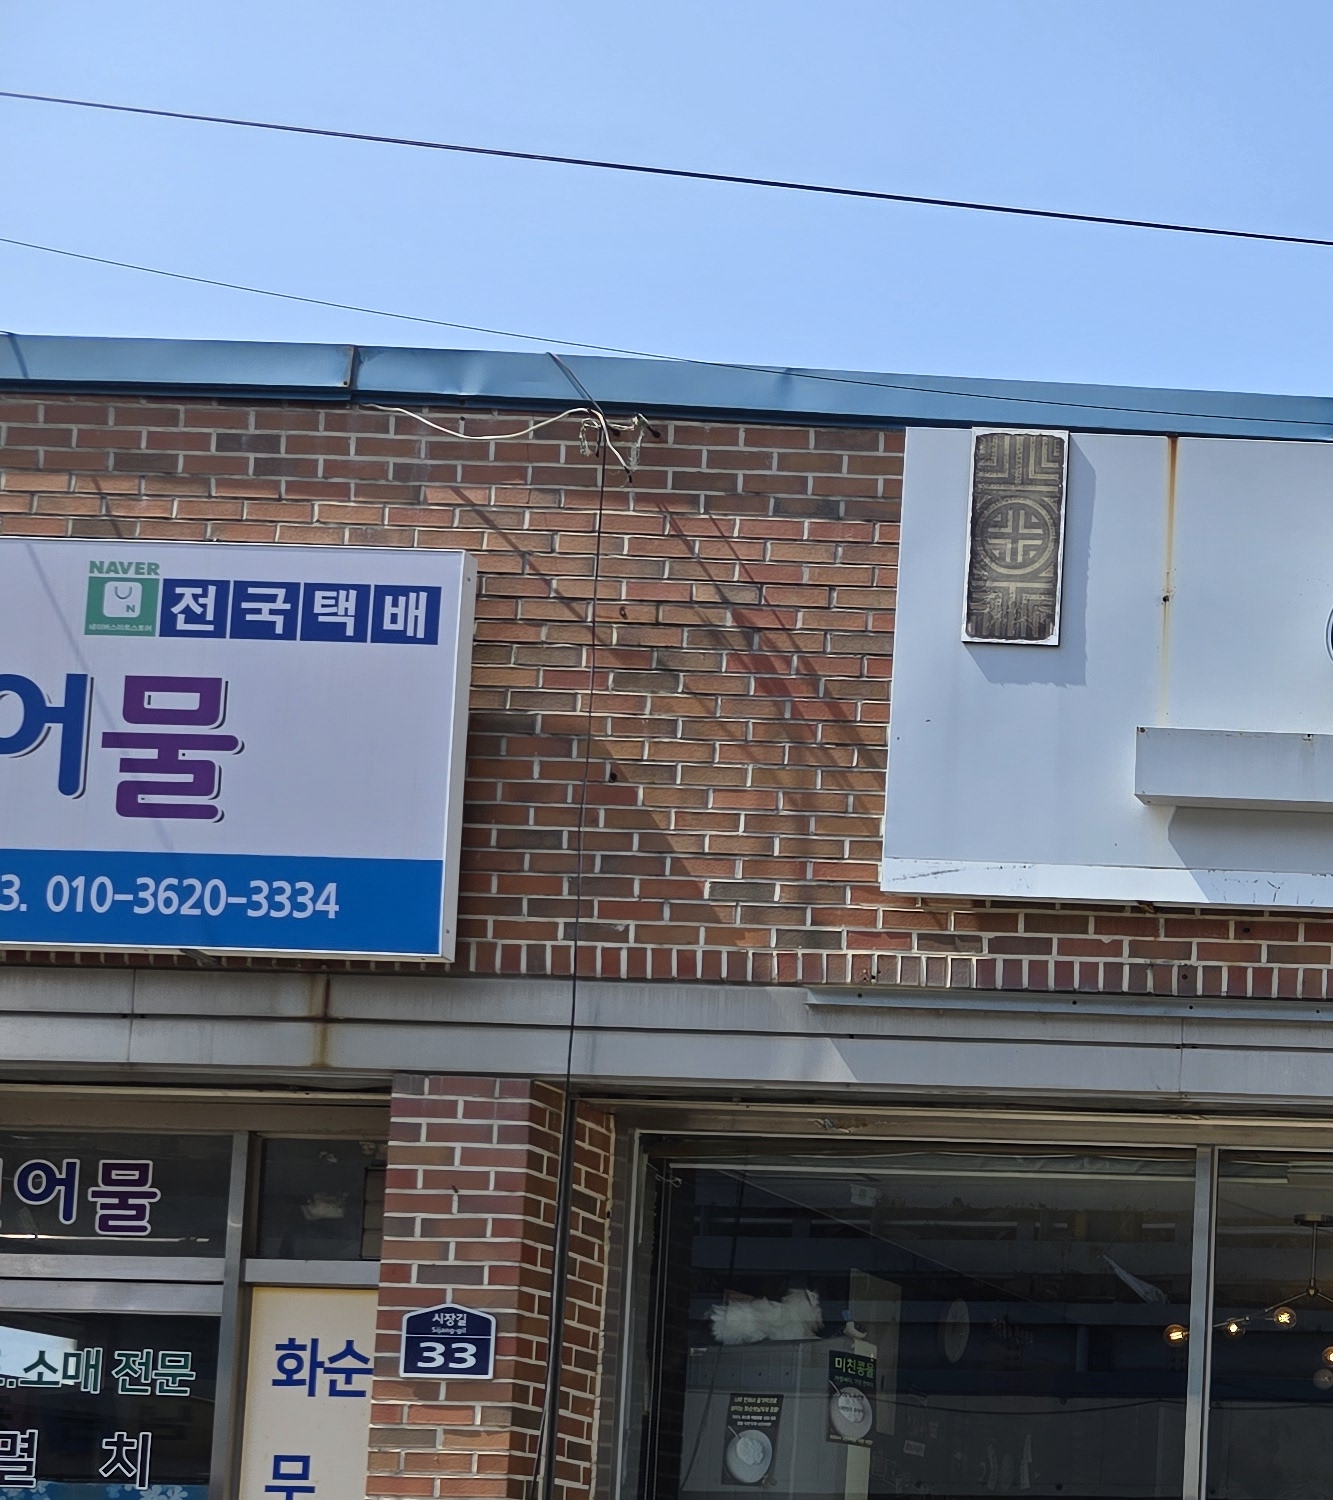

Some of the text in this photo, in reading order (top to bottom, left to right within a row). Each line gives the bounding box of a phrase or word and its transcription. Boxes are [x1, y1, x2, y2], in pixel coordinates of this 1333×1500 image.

[89, 560, 160, 576] NAVER
[170, 584, 428, 639] 전국택배
[0, 673, 240, 820] 어물
[46, 874, 340, 919] 010-3620-3334
[432, 1313, 467, 1327] 시장길
[112, 1349, 195, 1396] 전문
[272, 1337, 374, 1398] 화순
[417, 1342, 477, 1368] 33
